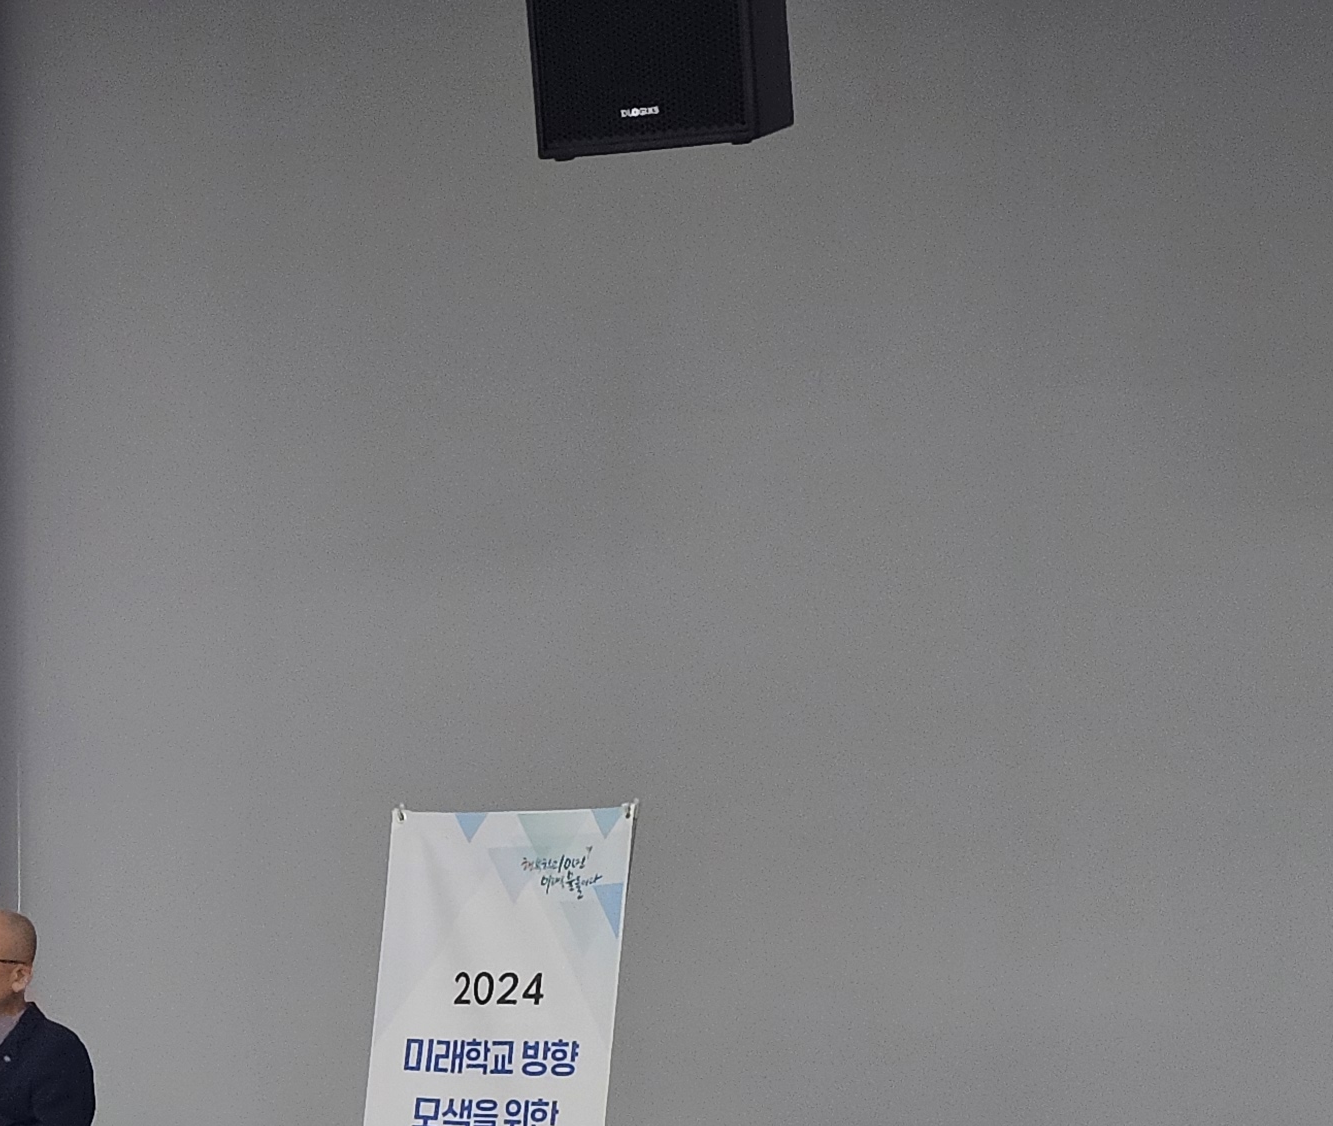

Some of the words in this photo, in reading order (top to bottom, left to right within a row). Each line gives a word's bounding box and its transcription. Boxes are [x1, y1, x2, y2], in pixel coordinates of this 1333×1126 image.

[453, 971, 544, 1006] 2024
[403, 1038, 515, 1076] 미래학교
[521, 1038, 580, 1077] 방향
